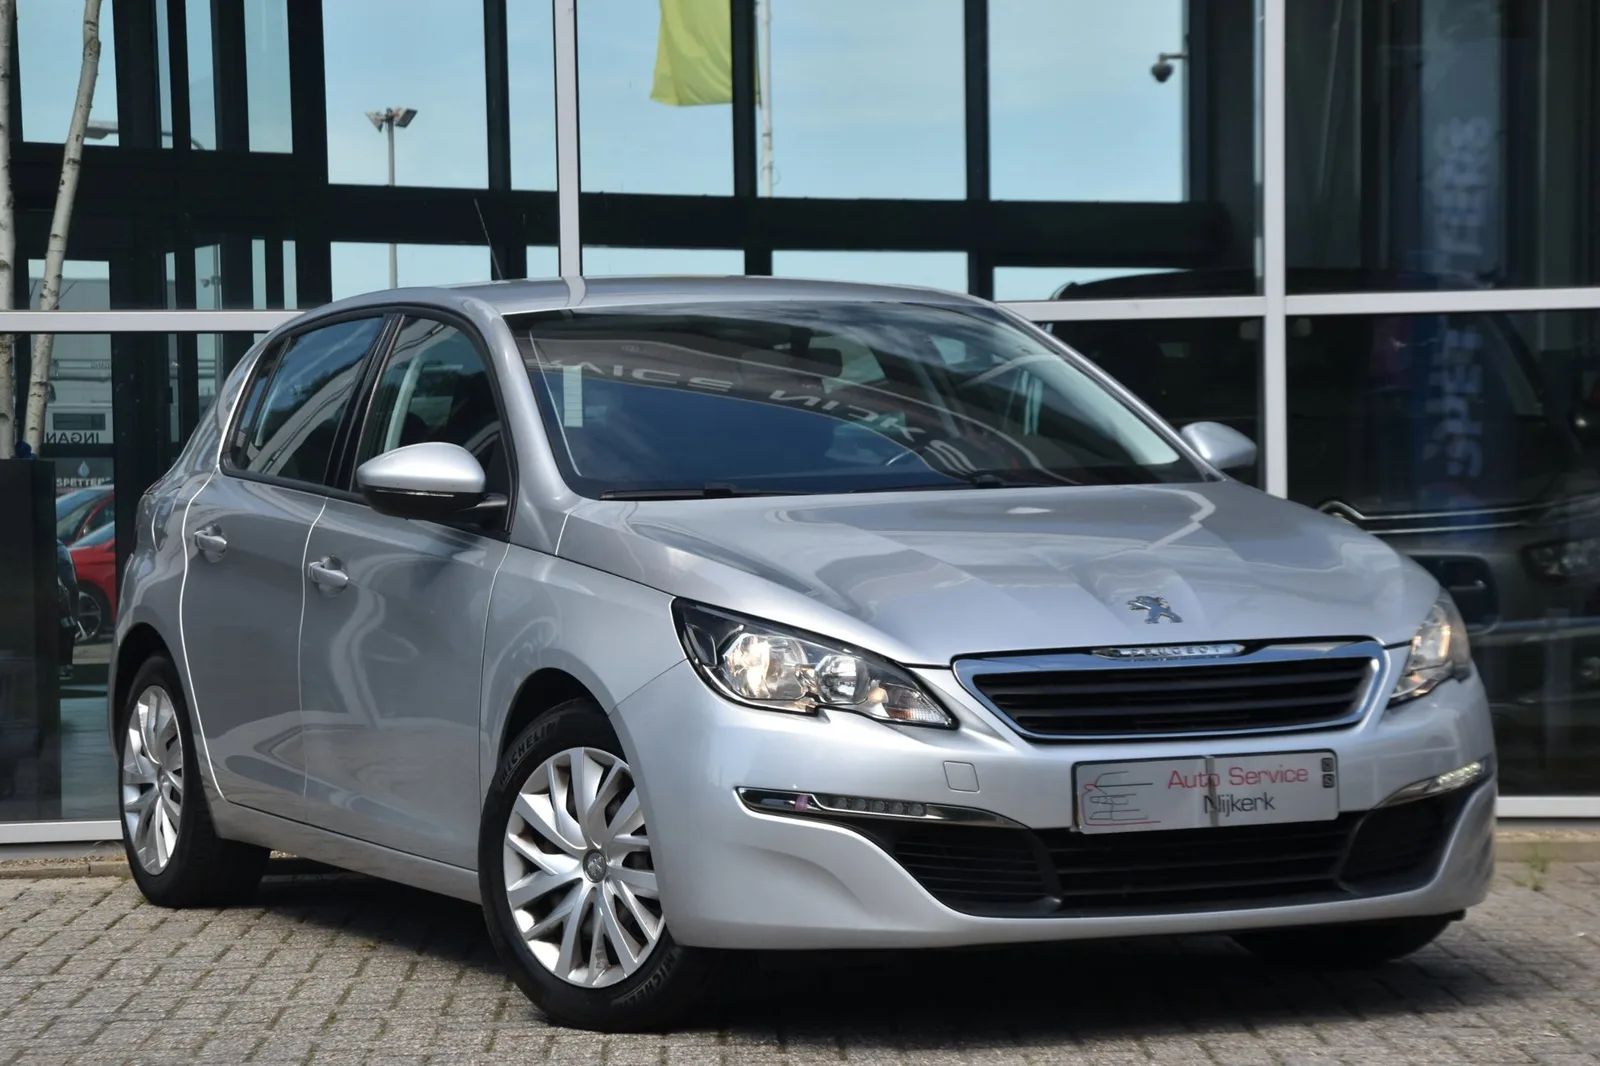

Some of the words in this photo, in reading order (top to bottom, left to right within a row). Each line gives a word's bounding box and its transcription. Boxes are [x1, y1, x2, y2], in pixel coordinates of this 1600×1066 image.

[1131, 646, 1220, 658] PEUGEOT
[1168, 770, 1220, 788] Auto
[1228, 764, 1308, 785] Service
[1204, 791, 1276, 817] Nijkerk
